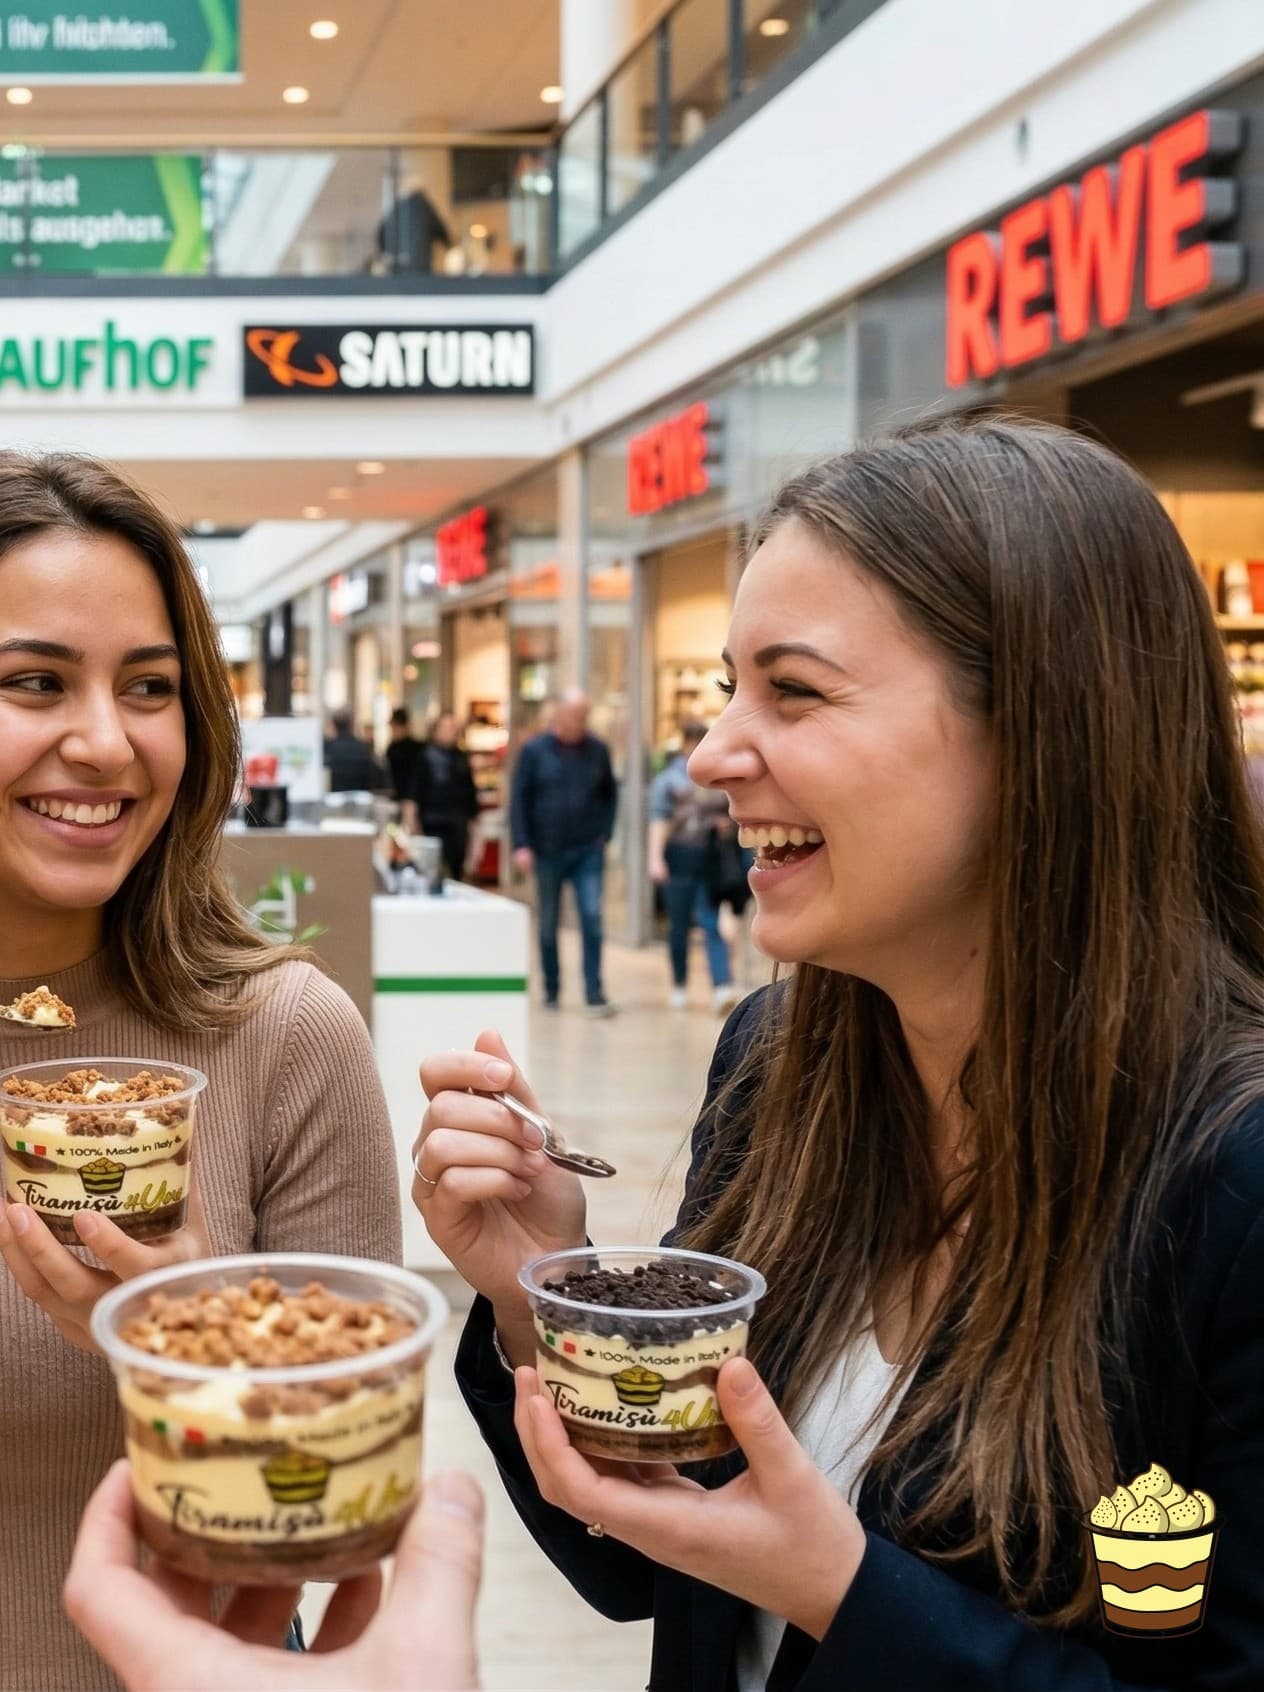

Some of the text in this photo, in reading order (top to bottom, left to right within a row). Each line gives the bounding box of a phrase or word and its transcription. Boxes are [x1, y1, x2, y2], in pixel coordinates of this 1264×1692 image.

[945, 109, 1213, 389] REWE
[339, 330, 532, 388] SATURN
[69, 1148, 103, 1157] 100%
[106, 1146, 140, 1156] Made
[142, 1144, 152, 1152] in
[639, 1355, 681, 1365] Made
[683, 1354, 695, 1363] in
[544, 1379, 662, 1428] Tiramisù
